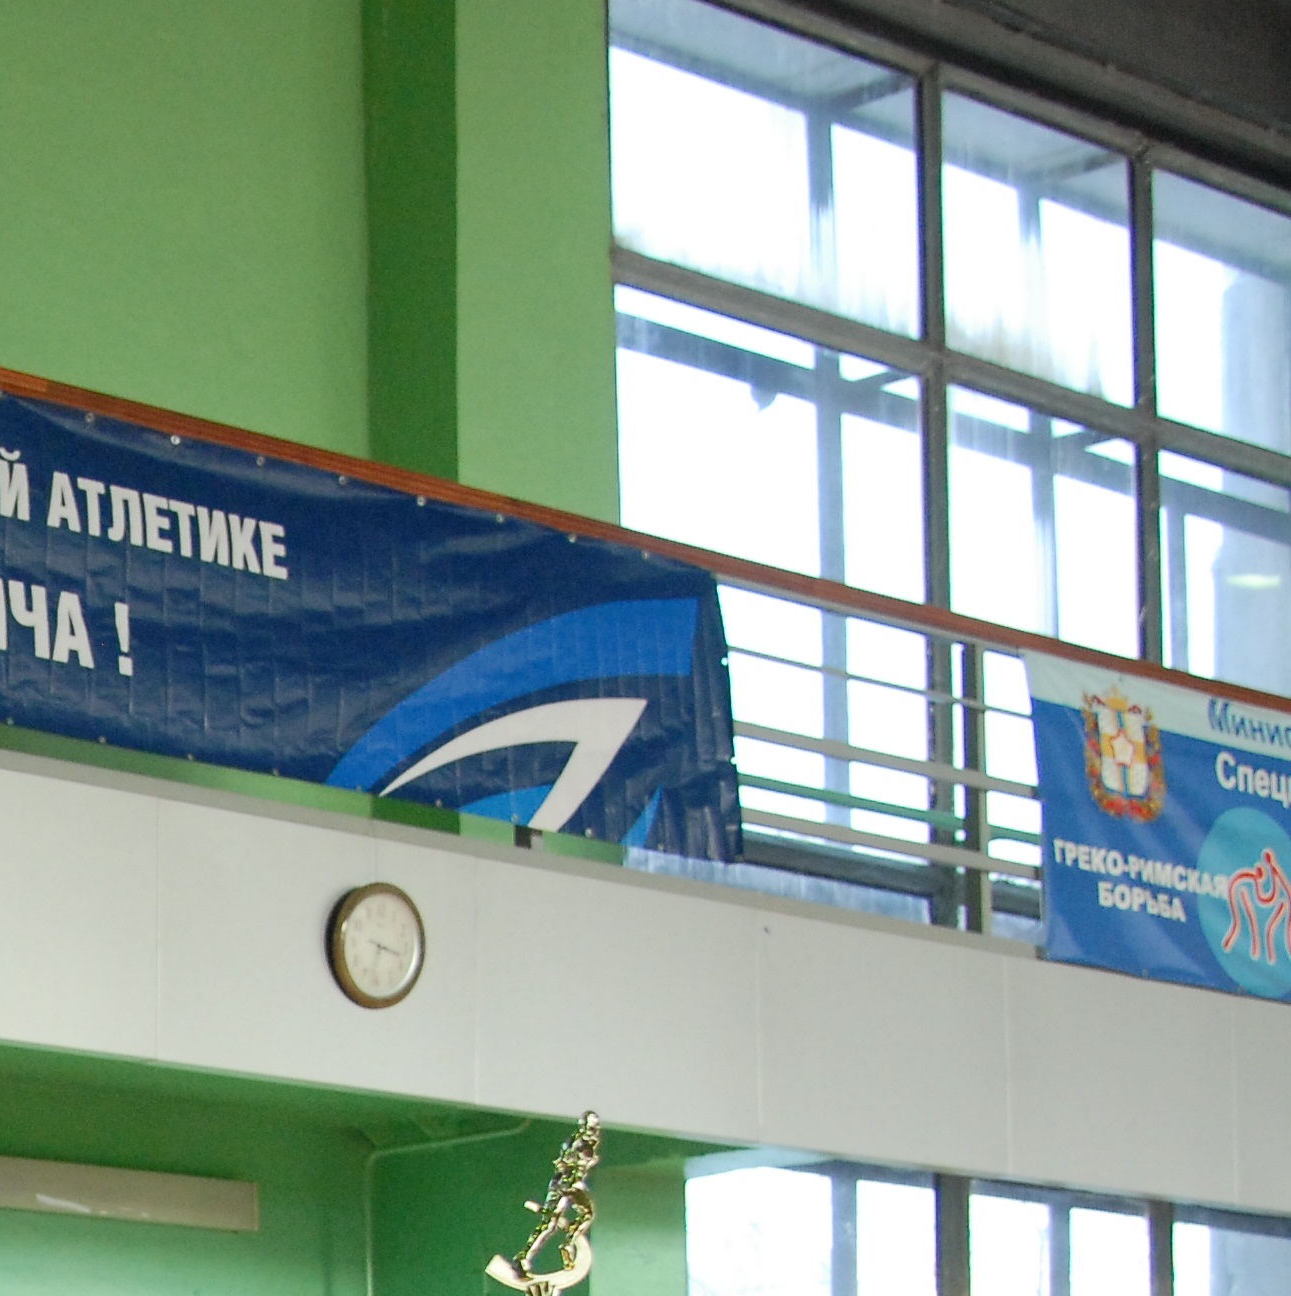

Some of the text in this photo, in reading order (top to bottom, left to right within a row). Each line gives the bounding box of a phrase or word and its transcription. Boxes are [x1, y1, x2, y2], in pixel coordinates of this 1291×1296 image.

[46, 472, 289, 580] АТЛЕТИКЕ
[115, 601, 134, 677] !
[1215, 751, 1291, 809] Спец
[1053, 839, 1229, 900] ГРЕКО-РИМСКАЯ
[1098, 882, 1186, 923] БОРЬБА
